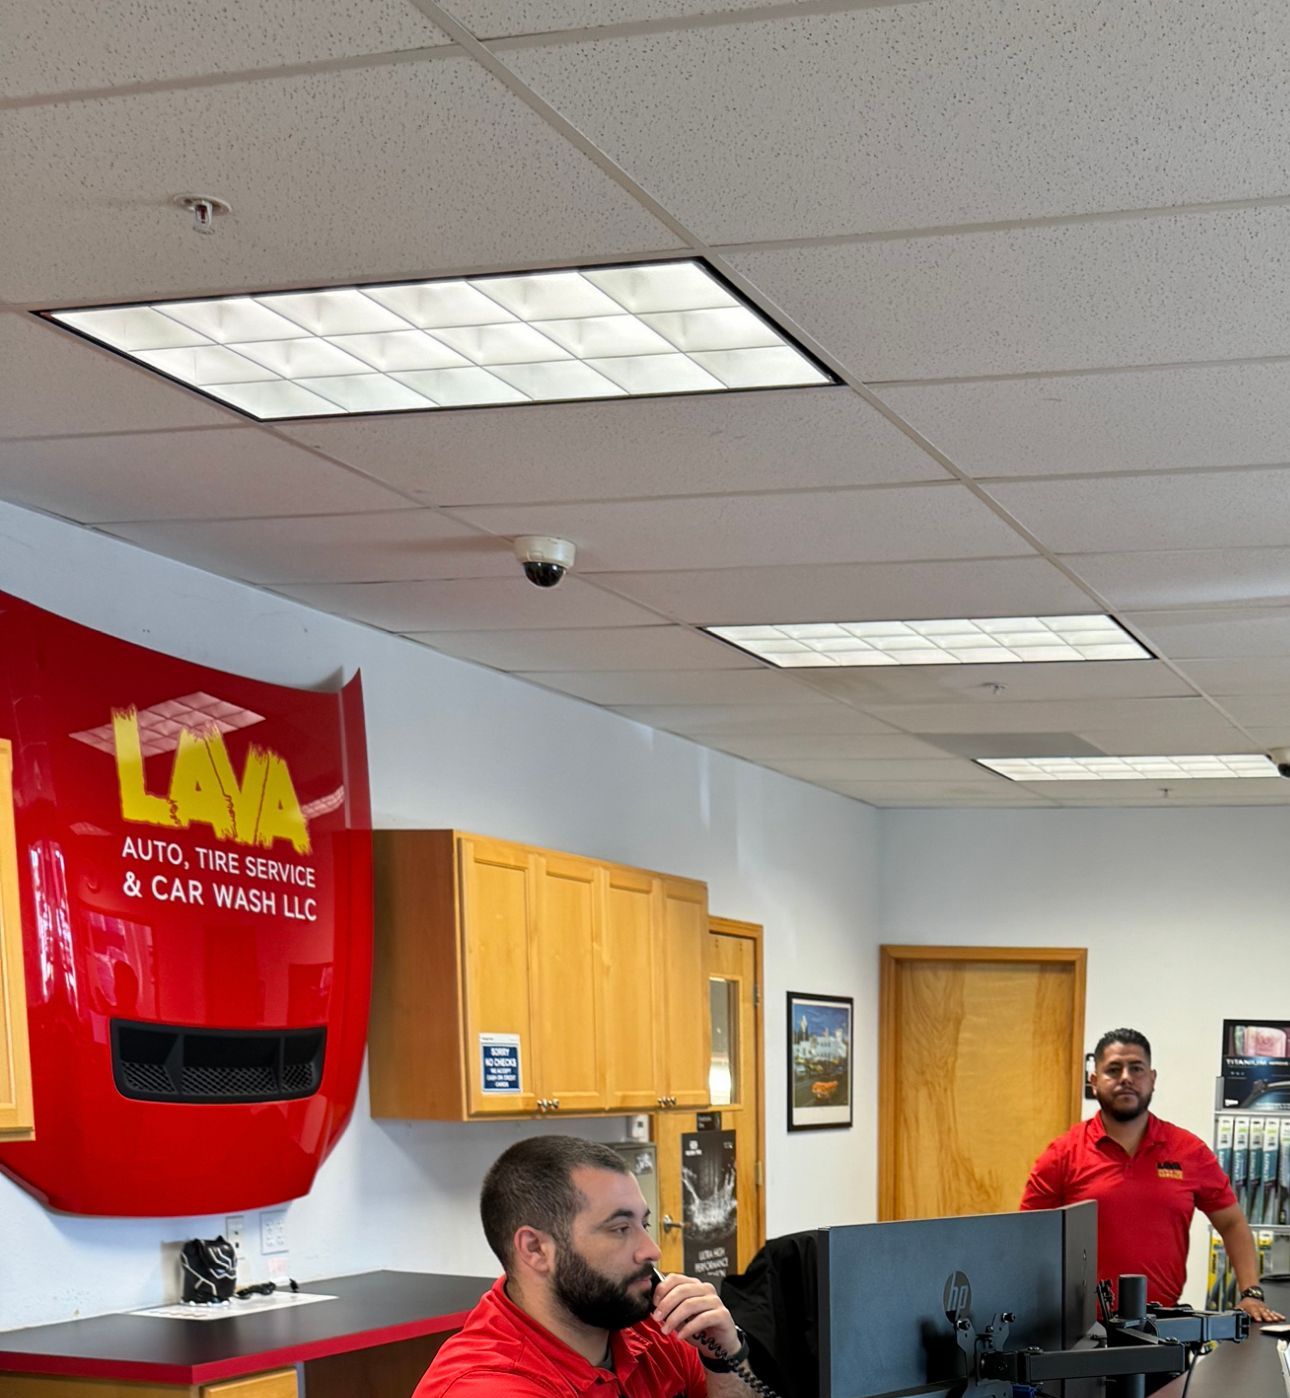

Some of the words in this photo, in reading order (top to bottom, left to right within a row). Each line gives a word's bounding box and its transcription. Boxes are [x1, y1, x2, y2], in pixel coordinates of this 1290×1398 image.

[111, 703, 313, 856] LAVA
[122, 836, 189, 870] AUTO,
[195, 847, 240, 875] TIRE
[245, 855, 315, 888] SERVICE
[123, 870, 142, 898] &
[151, 875, 204, 906] CAR
[212, 882, 276, 915] WASH
[283, 894, 317, 922] LLC
[947, 1271, 969, 1321] hp
